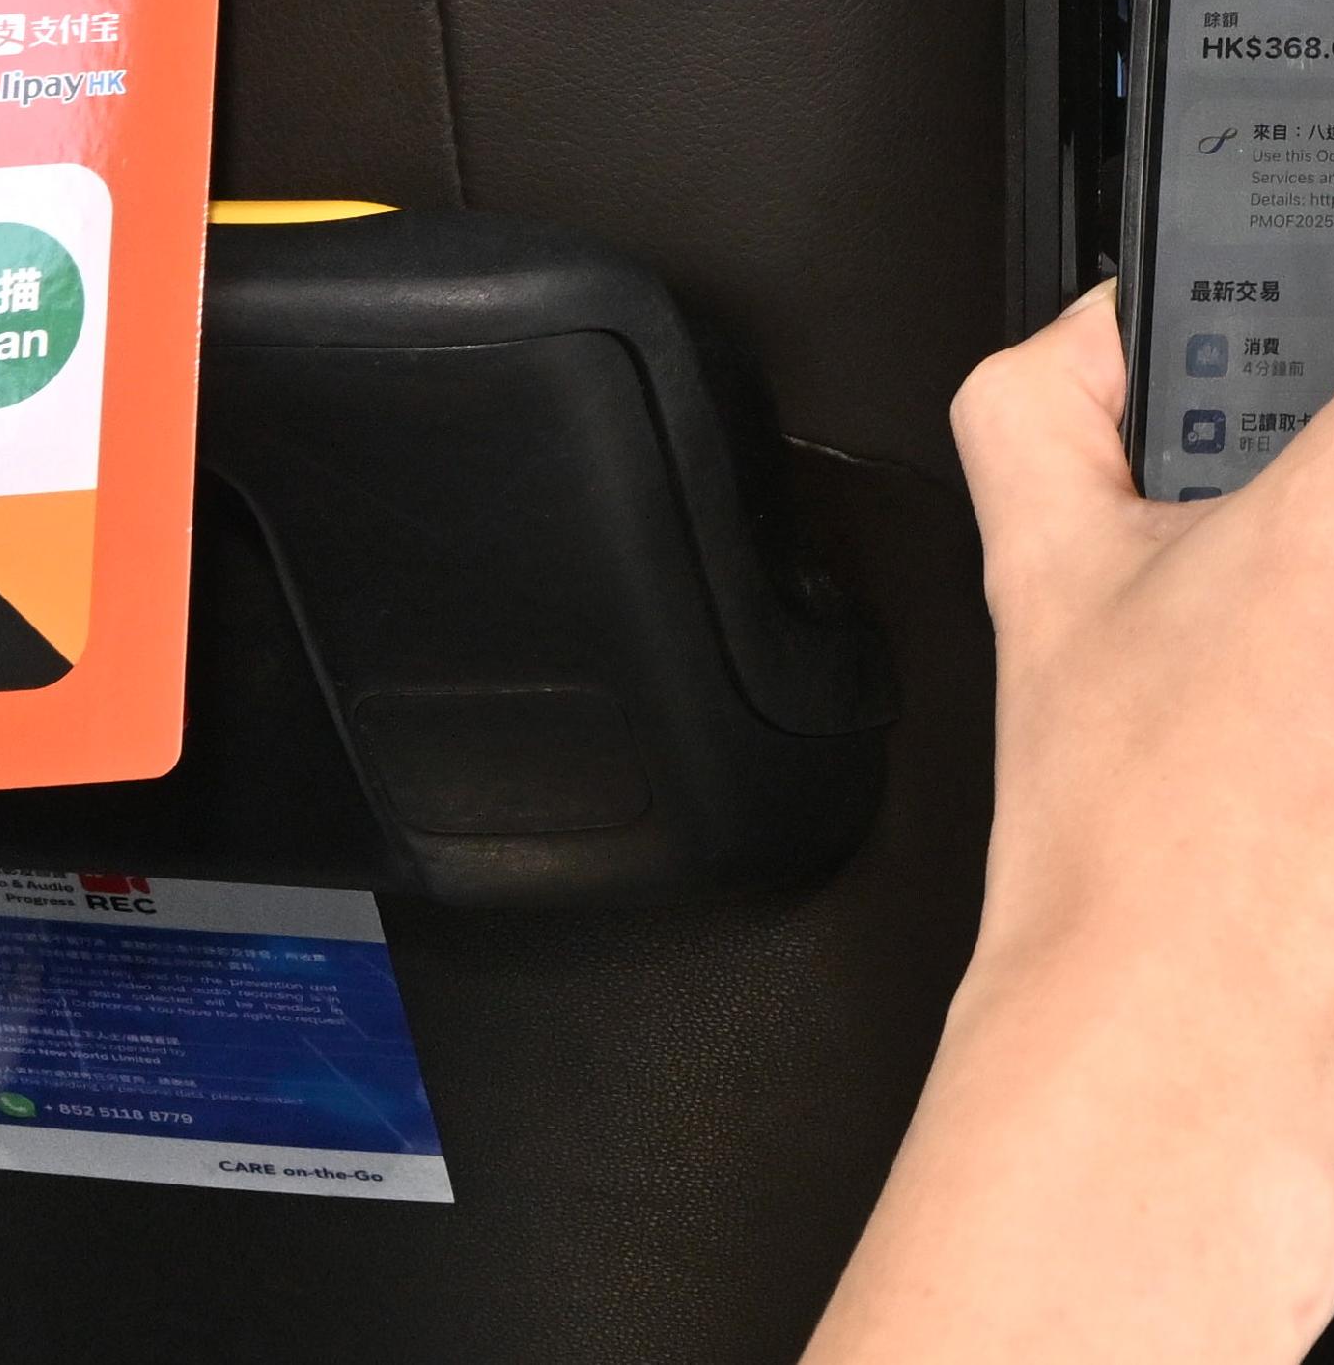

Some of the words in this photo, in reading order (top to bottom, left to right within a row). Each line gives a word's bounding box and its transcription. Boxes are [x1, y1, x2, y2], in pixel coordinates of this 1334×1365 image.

[1203, 11, 1239, 29] 餘額
[29, 11, 121, 48] 支付宝
[1253, 149, 1282, 163] Use
[1285, 148, 1312, 163] this
[1252, 171, 1315, 185] Services
[1250, 192, 1305, 207] Details:
[1191, 281, 1280, 303] 最新交易
[1244, 338, 1280, 356] 消費
[1239, 436, 1271, 453] 昨日
[26, 880, 75, 892] Audio
[6, 893, 75, 907] Progress
[85, 894, 158, 915] REC
[112, 1053, 161, 1065] Limited
[59, 1103, 94, 1116] 852
[100, 1106, 144, 1121] 5118
[149, 1110, 194, 1126] 8779
[218, 1159, 276, 1177] CARE
[282, 1165, 384, 1184] on-the-Go
